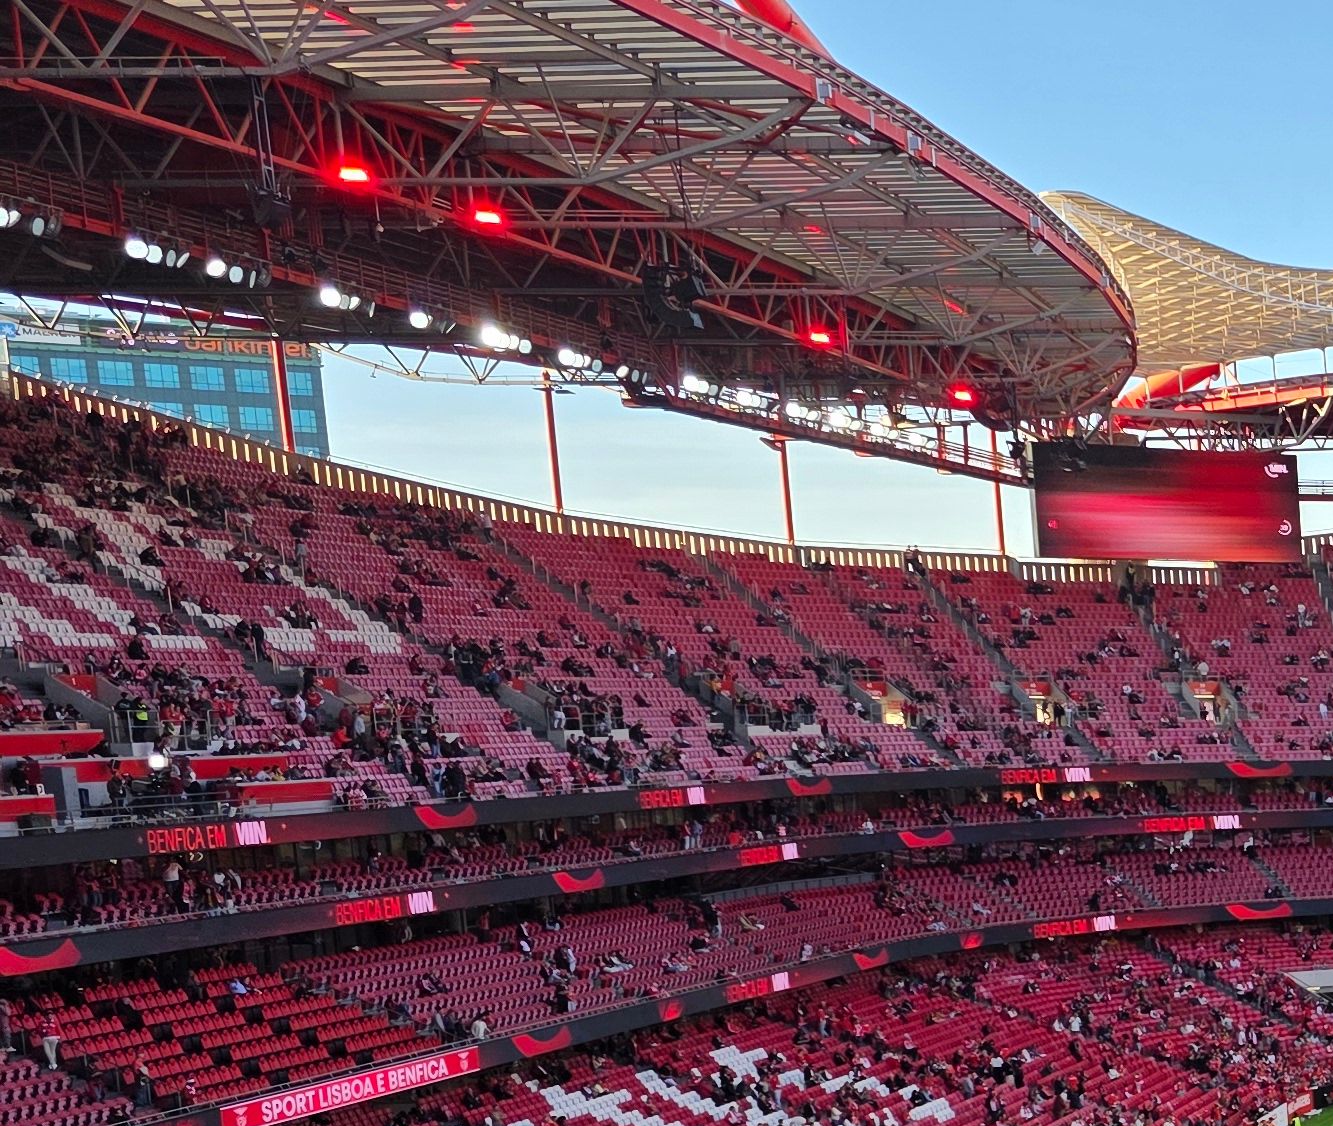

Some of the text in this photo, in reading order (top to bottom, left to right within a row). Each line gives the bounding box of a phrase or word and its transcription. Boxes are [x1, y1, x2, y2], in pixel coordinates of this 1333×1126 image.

[184, 333, 311, 359] bankiner
[147, 826, 206, 854] BENFICA
[206, 823, 228, 849] EM
[336, 899, 381, 926] BENFICA
[383, 895, 402, 918] EM
[261, 1057, 450, 1124] SPORT LISBOA E BENFICA
